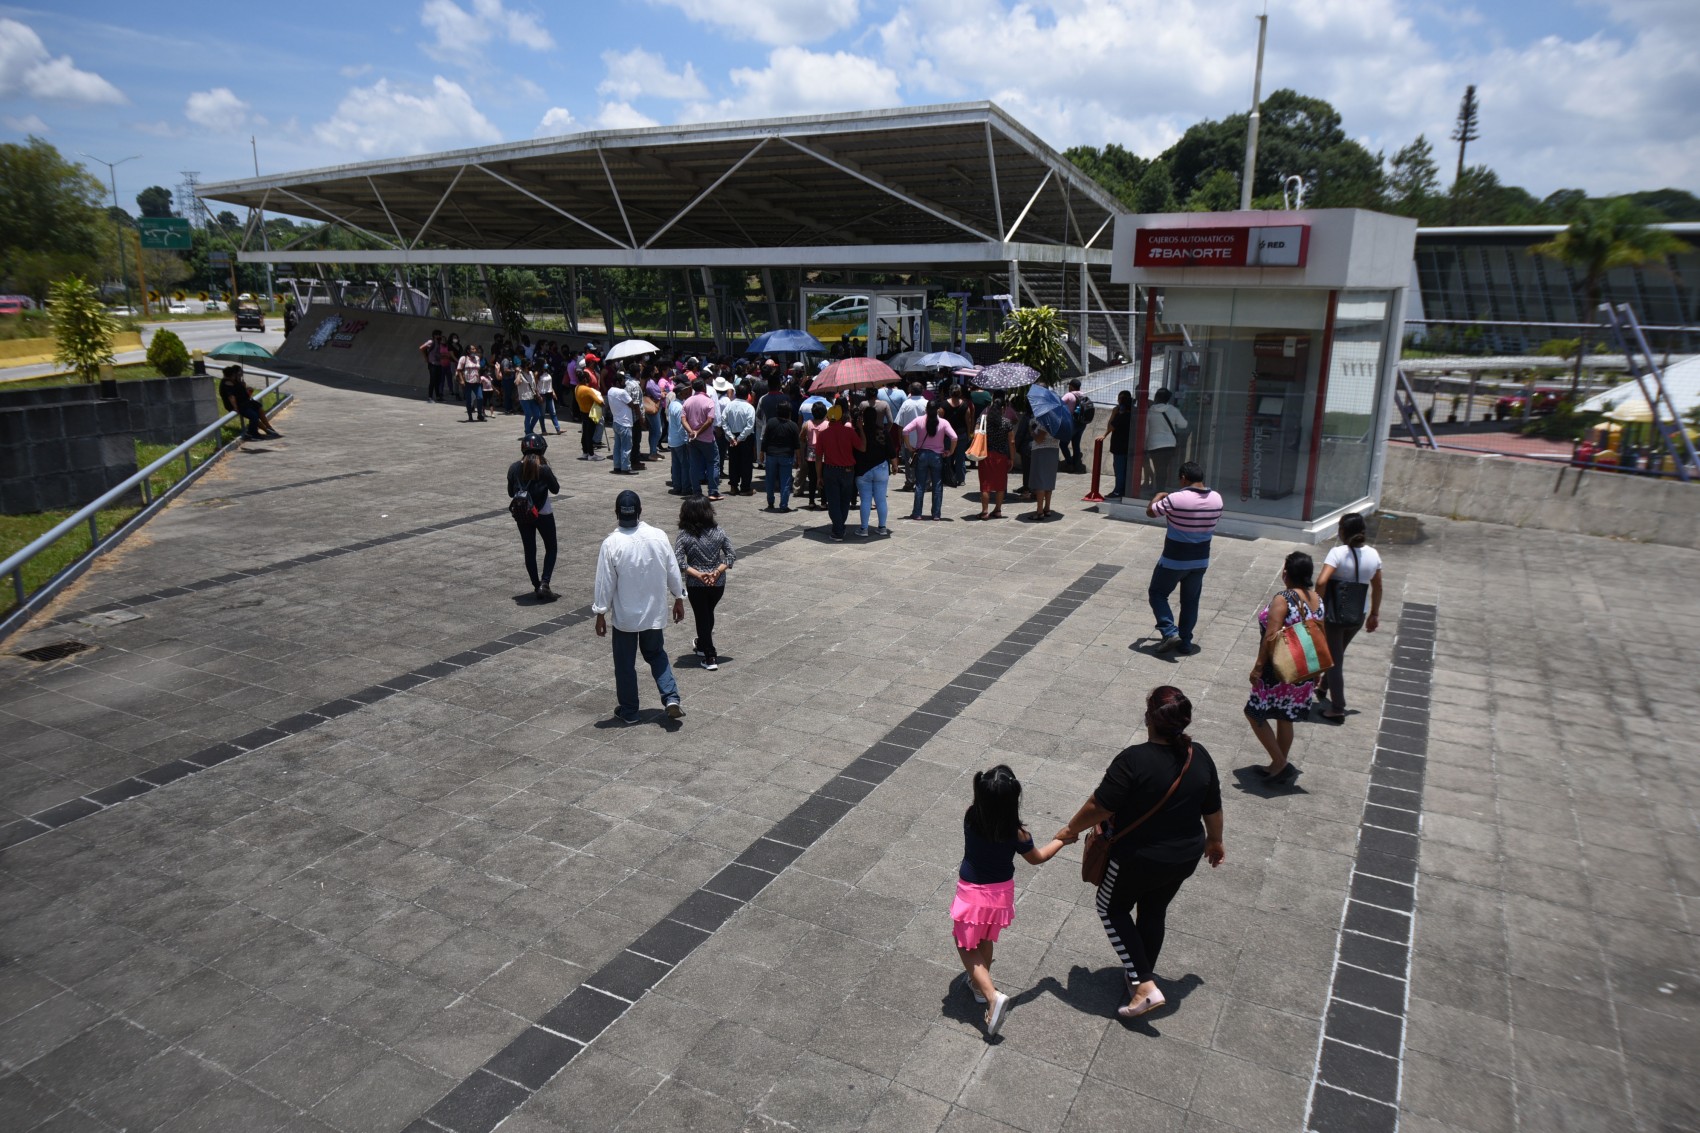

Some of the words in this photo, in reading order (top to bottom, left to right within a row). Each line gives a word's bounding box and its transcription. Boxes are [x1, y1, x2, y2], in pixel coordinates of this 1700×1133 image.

[1148, 235, 1179, 244] CAJEROS
[1180, 235, 1235, 243] AUTOMATICOS
[1162, 248, 1232, 258] BANORTE
[1252, 427, 1263, 488] BANORTE
